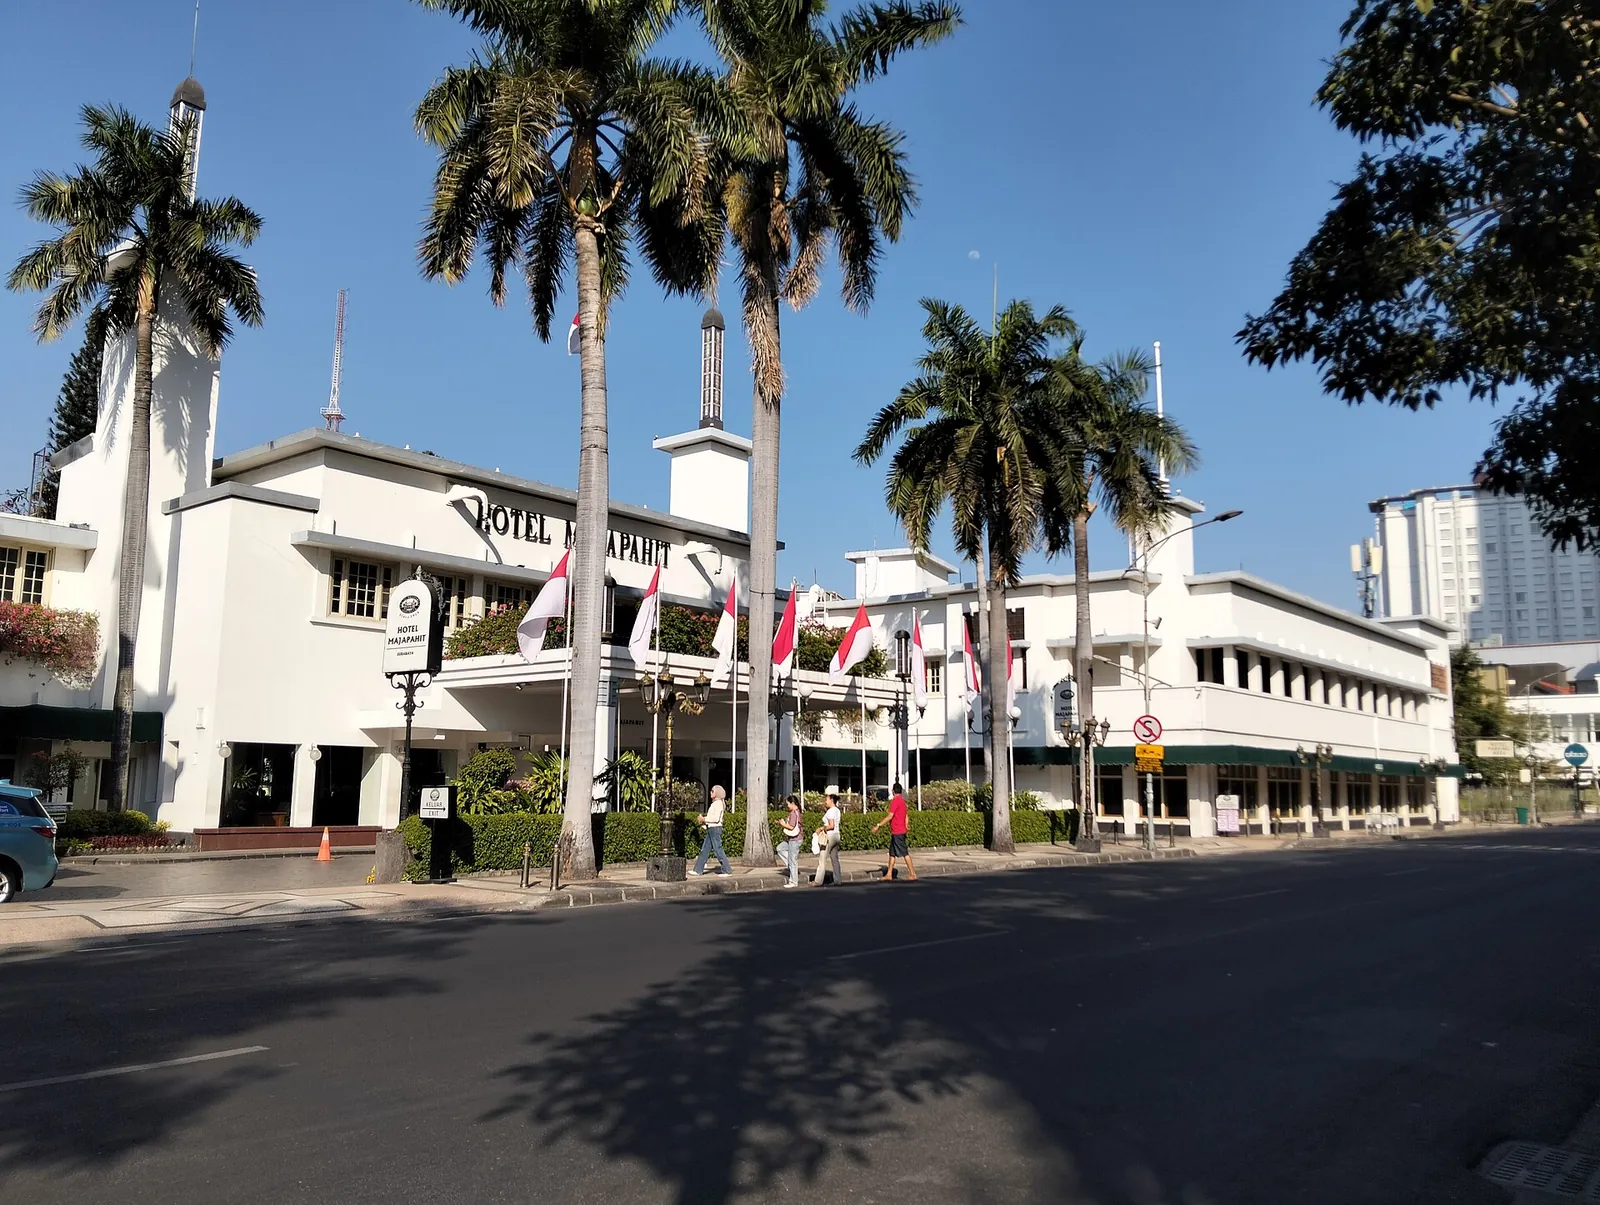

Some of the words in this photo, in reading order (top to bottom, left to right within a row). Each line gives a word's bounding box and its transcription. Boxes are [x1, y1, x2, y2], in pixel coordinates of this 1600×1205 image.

[476, 500, 551, 545] HOTEL
[564, 519, 671, 568] MAPAHIT
[397, 625, 418, 634] HOTEL
[387, 634, 426, 646] MAJAPAHIT
